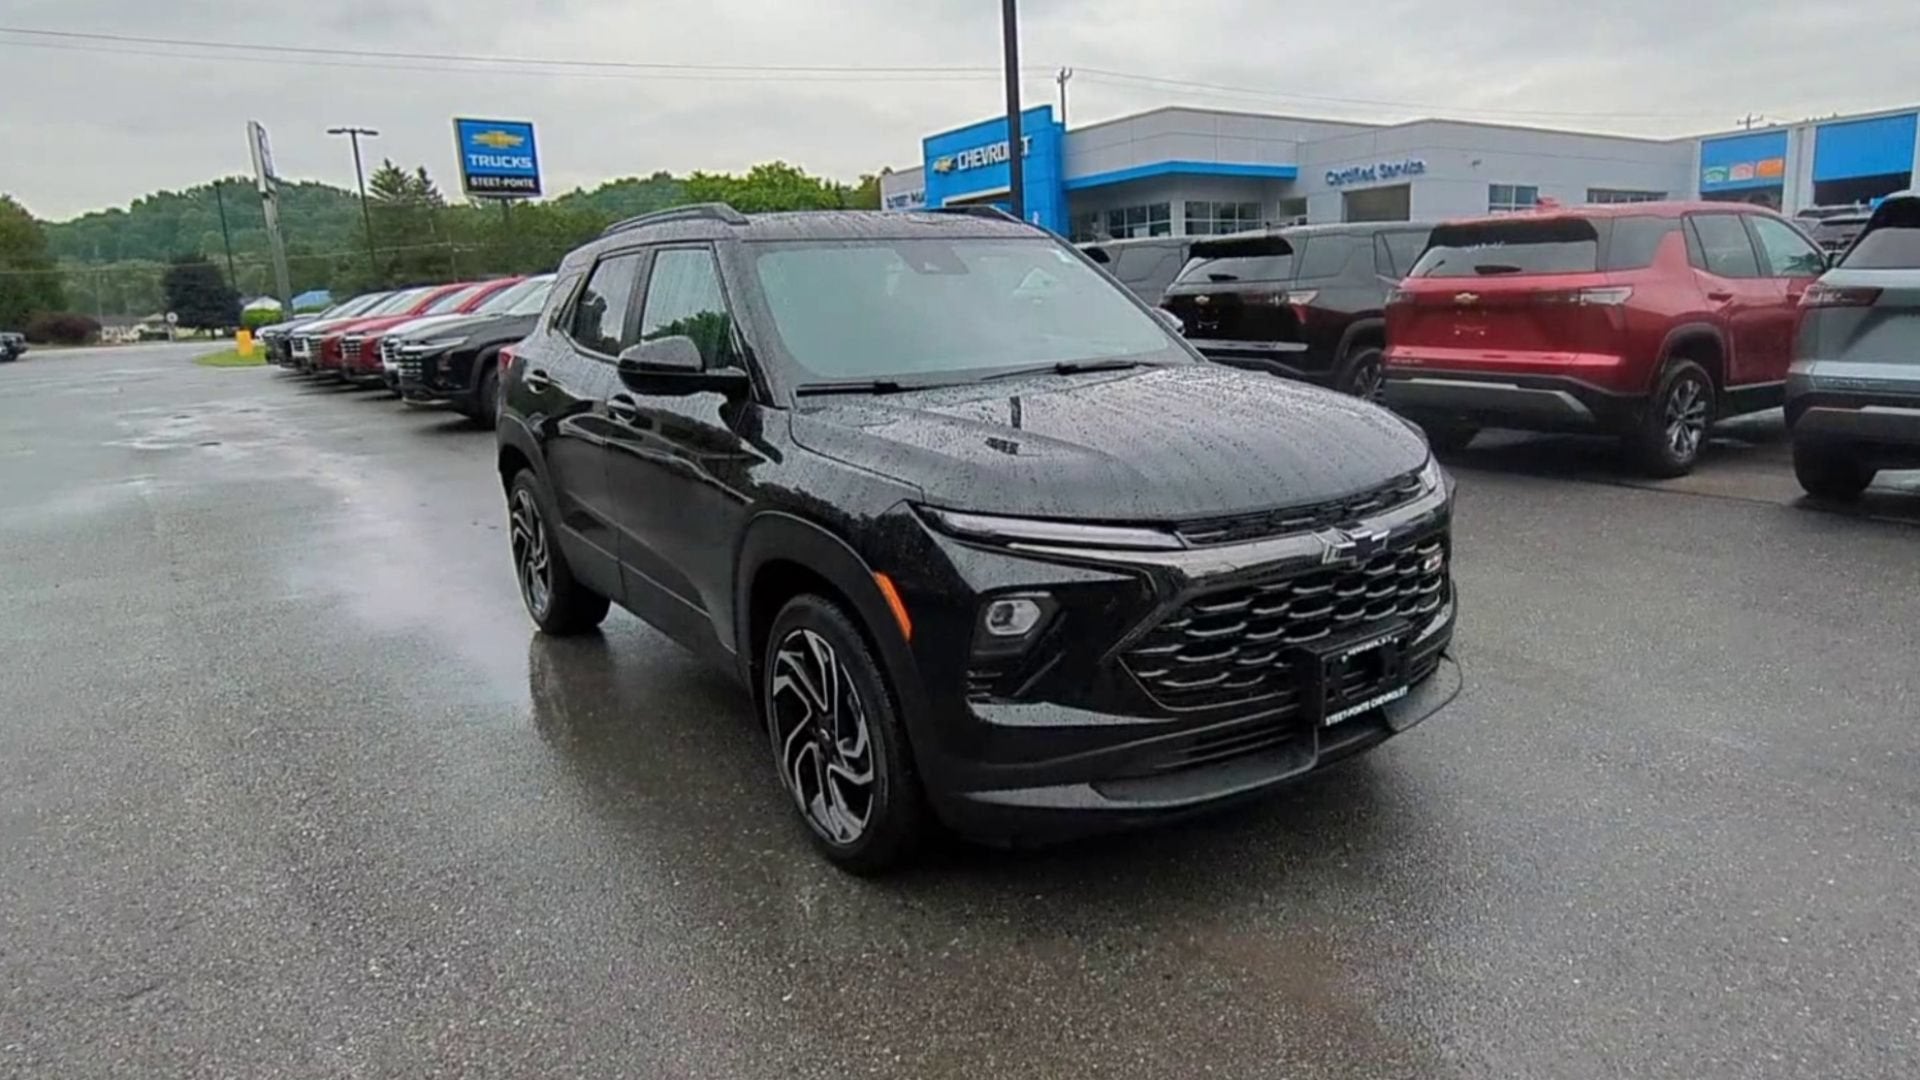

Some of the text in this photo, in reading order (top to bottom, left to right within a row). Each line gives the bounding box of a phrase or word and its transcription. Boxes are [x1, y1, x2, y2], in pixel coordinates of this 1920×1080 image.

[468, 154, 532, 168] TRUCKS
[958, 135, 1031, 170] CHEVROT
[1380, 160, 1425, 178] Service
